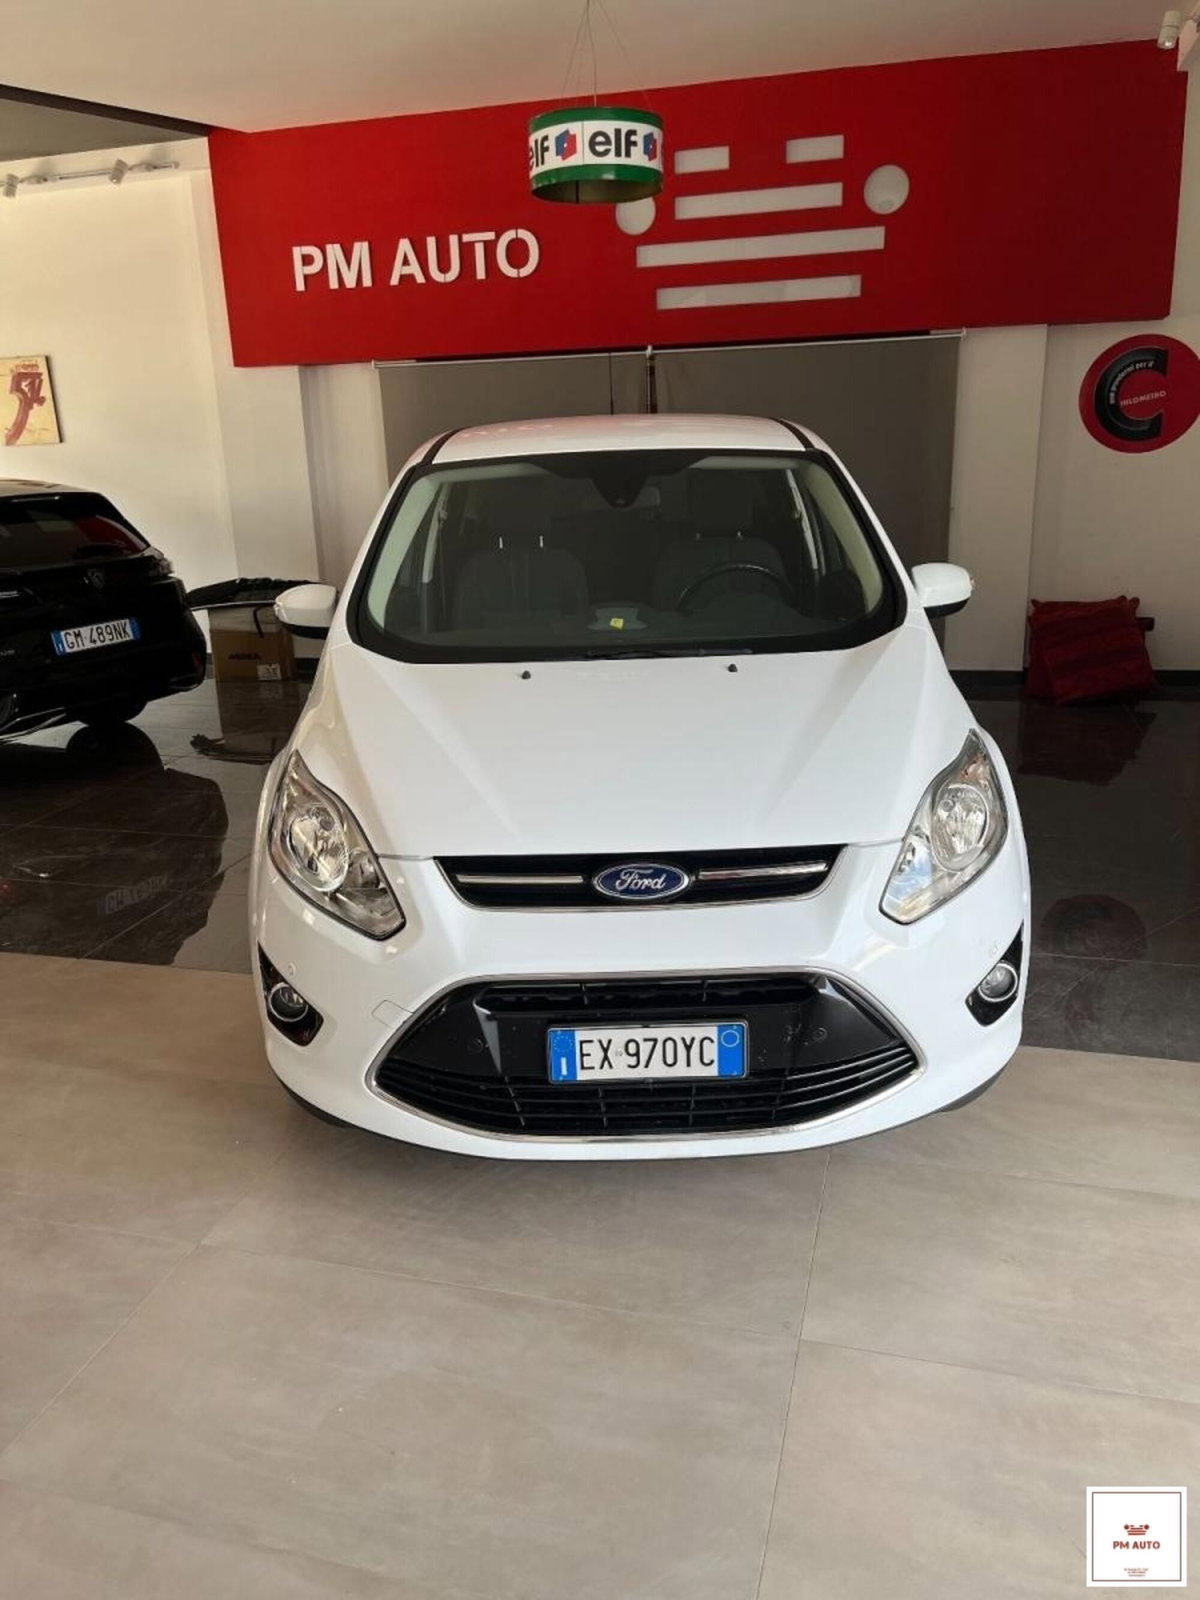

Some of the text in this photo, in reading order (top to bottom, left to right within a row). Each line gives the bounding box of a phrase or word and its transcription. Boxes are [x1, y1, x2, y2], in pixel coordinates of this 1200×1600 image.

[588, 128, 638, 158] elf
[292, 228, 540, 292] PM AUTO
[63, 621, 131, 650] GM 489NK
[615, 868, 667, 890] Ford
[579, 1036, 715, 1071] EX 970YC
